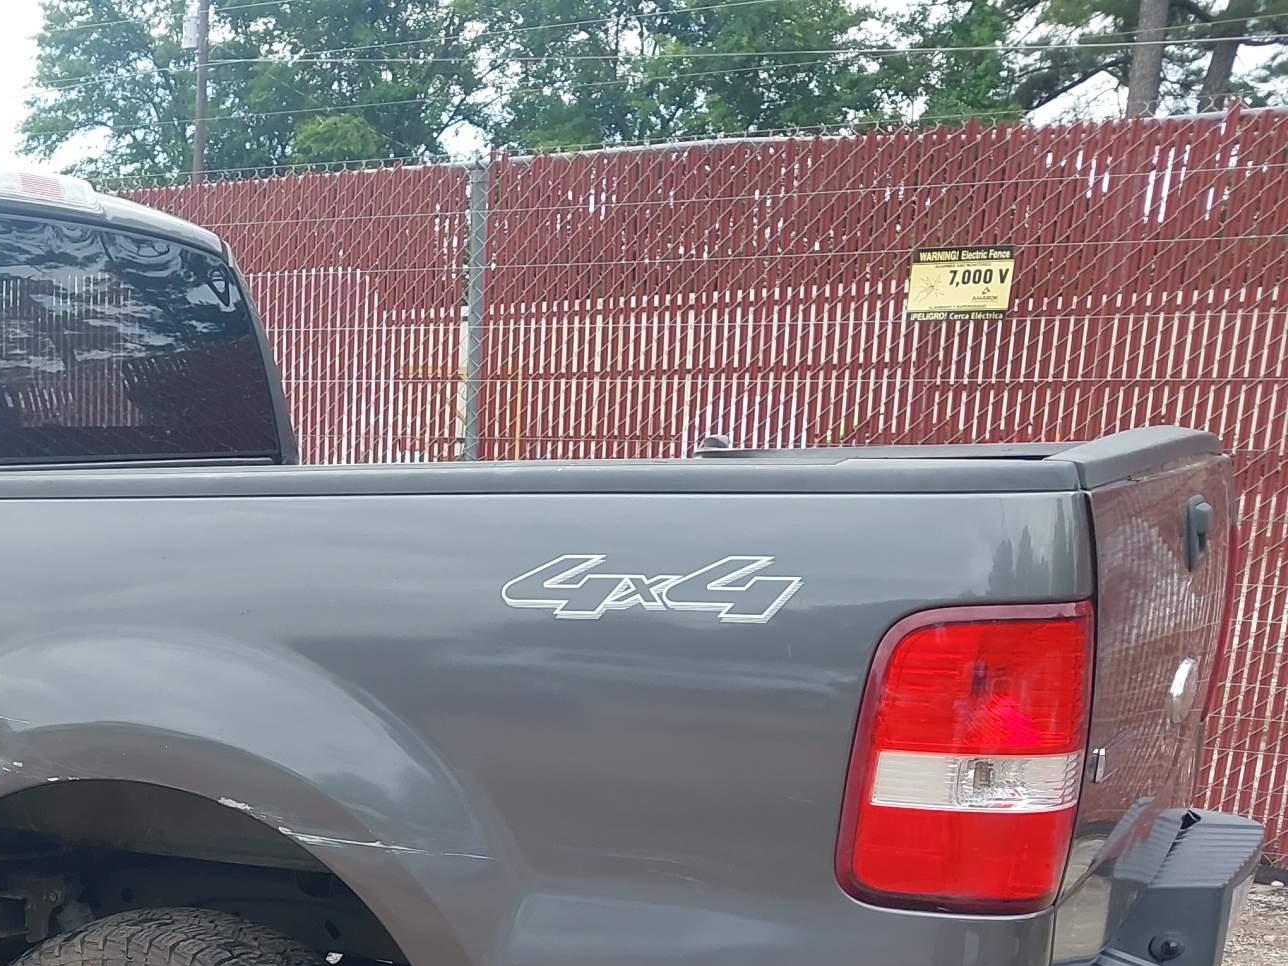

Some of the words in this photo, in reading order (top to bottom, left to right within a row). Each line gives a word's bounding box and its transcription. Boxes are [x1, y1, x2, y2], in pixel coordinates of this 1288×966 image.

[919, 250, 959, 261] WARNING!
[961, 249, 987, 260] Electric
[988, 248, 1011, 259] Fence
[948, 268, 993, 288] 7,000
[998, 268, 1009, 284] V
[949, 312, 969, 320] Cerca
[971, 311, 1003, 320] Eléctrica
